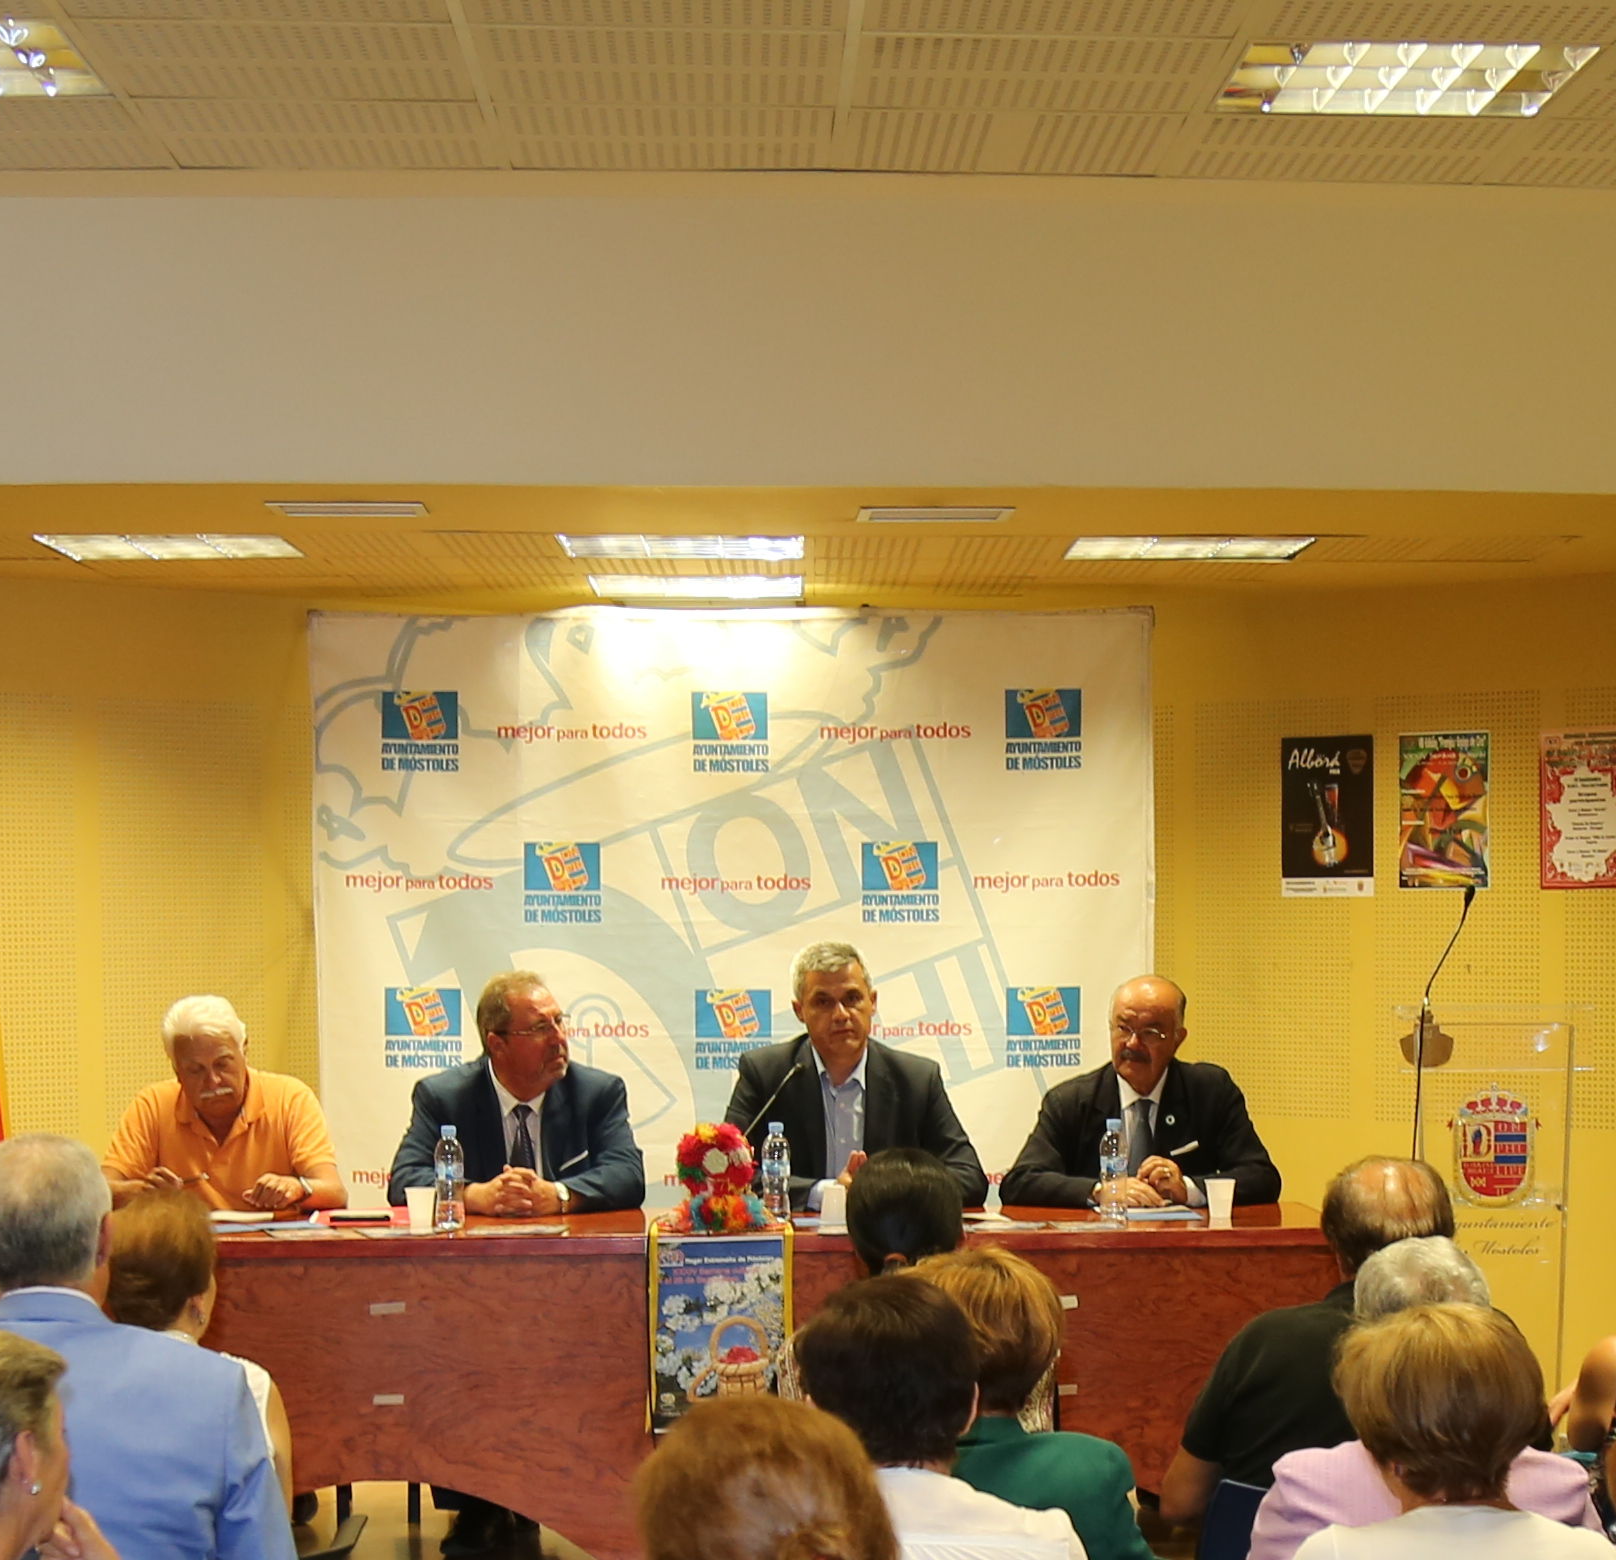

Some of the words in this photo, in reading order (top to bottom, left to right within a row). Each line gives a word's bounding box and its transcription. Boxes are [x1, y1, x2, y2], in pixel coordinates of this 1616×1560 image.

[497, 722, 556, 744] mejor
[557, 728, 588, 742] para
[592, 722, 647, 739] todos
[820, 722, 878, 744] mejor
[880, 728, 912, 742] para
[916, 722, 971, 739] todos
[381, 742, 459, 755] AYUNTAMIENTO
[693, 743, 768, 756] AYUNTAMIENTO
[1006, 740, 1082, 754] AYUNTAMIENTO
[382, 758, 396, 771] DE
[398, 756, 459, 772] MÓSTOLES
[694, 759, 707, 772] DE
[709, 757, 769, 773] MÓSTOLES
[1006, 757, 1020, 770] DE
[1022, 755, 1082, 770] MÓSTOLES
[345, 872, 403, 893] mejor
[405, 878, 434, 892] para
[438, 873, 494, 889] todos
[661, 873, 719, 894] mejor
[720, 880, 753, 893] para
[756, 874, 812, 890] todos
[973, 871, 1030, 892] mejor
[1032, 877, 1064, 890] para
[1068, 871, 1121, 888] todos
[523, 894, 602, 906] AYUNTAMIENTO
[862, 894, 939, 907] AYUNTAMIENTO
[524, 909, 539, 923] DE
[541, 906, 602, 923] MÓSTOLES
[863, 910, 877, 923] DE
[879, 907, 939, 923] MÓSTOLES
[594, 1021, 650, 1038] todos
[883, 1025, 915, 1038] para
[918, 1020, 973, 1037] todos
[385, 1040, 462, 1052] AYUNTAMIENTO
[1006, 1039, 1081, 1052] AYUNTAMIENTO
[385, 1055, 400, 1068] DE
[696, 1057, 709, 1070] DE
[1007, 1055, 1021, 1068] DE
[1023, 1052, 1081, 1068] MÓSTOLES
[1454, 1215, 1554, 1231] yuntamiento
